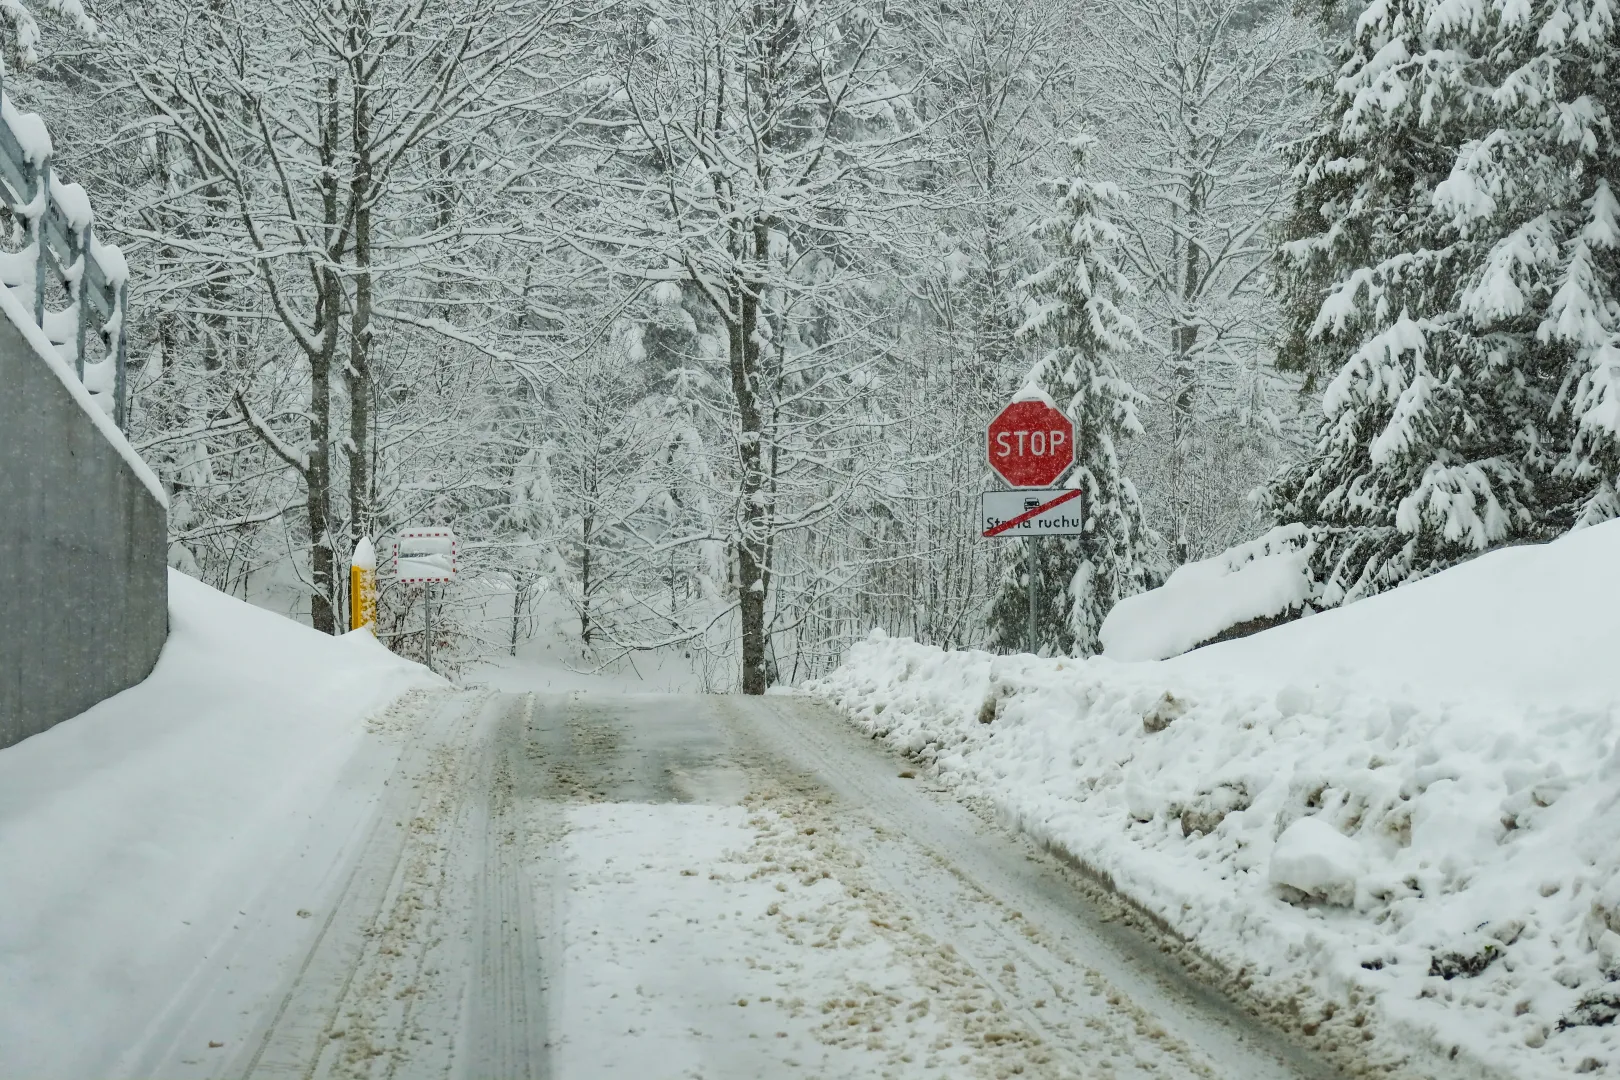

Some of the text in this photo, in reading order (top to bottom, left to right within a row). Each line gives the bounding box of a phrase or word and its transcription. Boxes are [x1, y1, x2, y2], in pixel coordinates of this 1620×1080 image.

[996, 430, 1065, 457] STOP
[986, 515, 1080, 529] Stra ruchu
